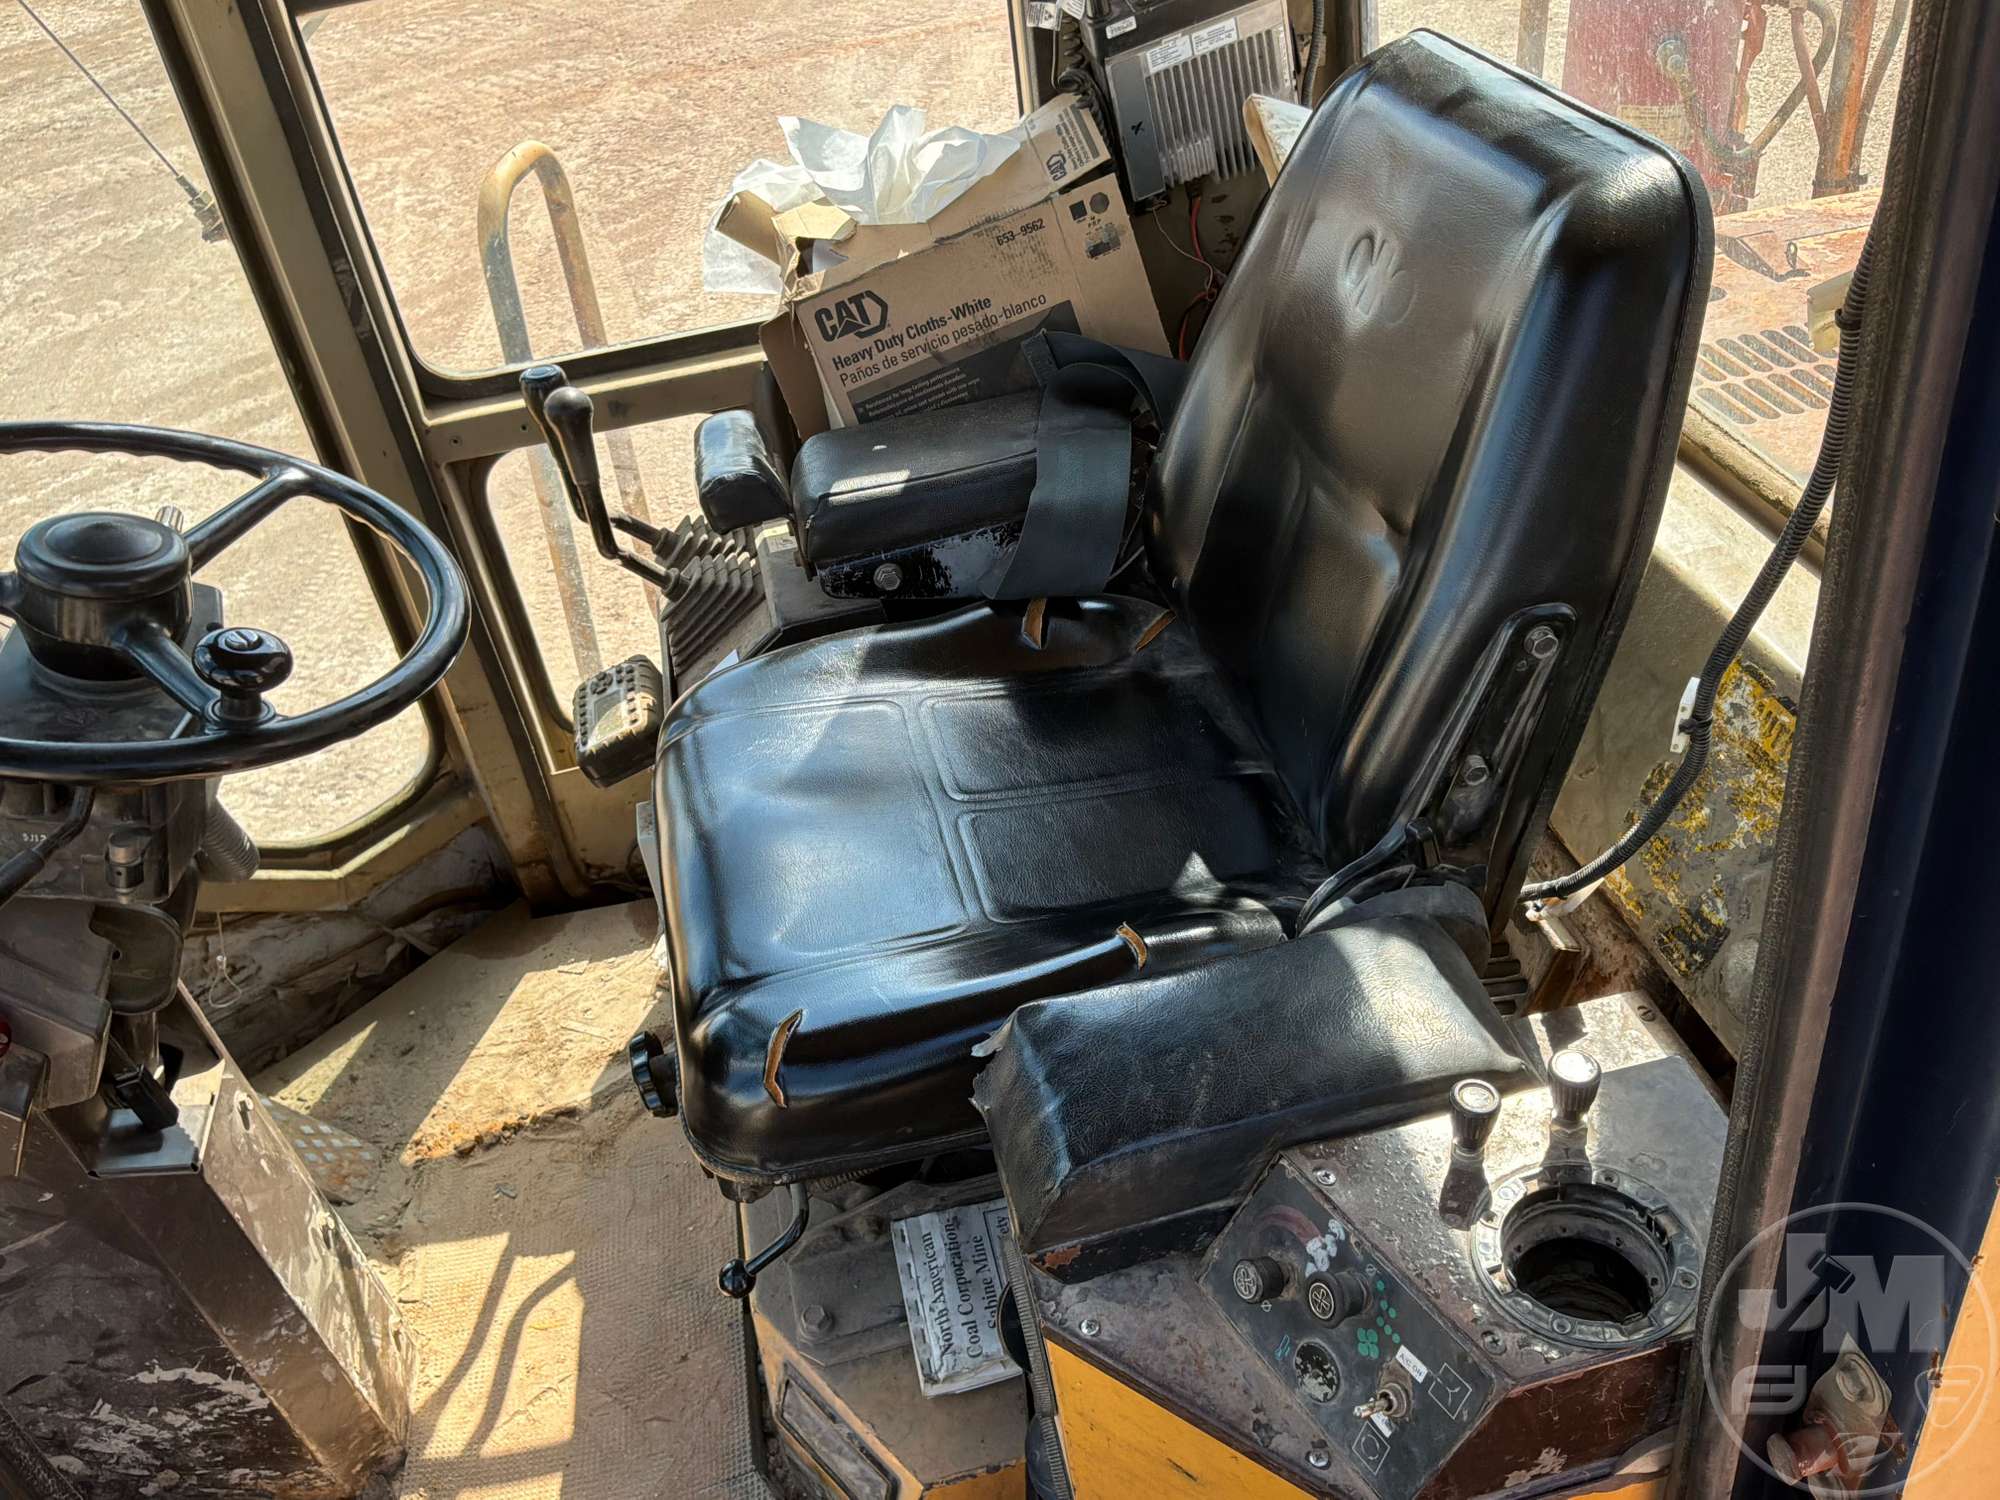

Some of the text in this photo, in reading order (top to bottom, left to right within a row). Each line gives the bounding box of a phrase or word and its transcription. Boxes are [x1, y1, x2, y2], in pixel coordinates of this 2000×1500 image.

[815, 290, 888, 342] CAT
[832, 297, 992, 371] Heavy Duty Cloths-White
[840, 294, 1047, 387] Paños de servicio pesado-blanco
[971, 1235, 991, 1274] Mine
[921, 1232, 956, 1356] North American
[961, 1320, 983, 1358] Coal
